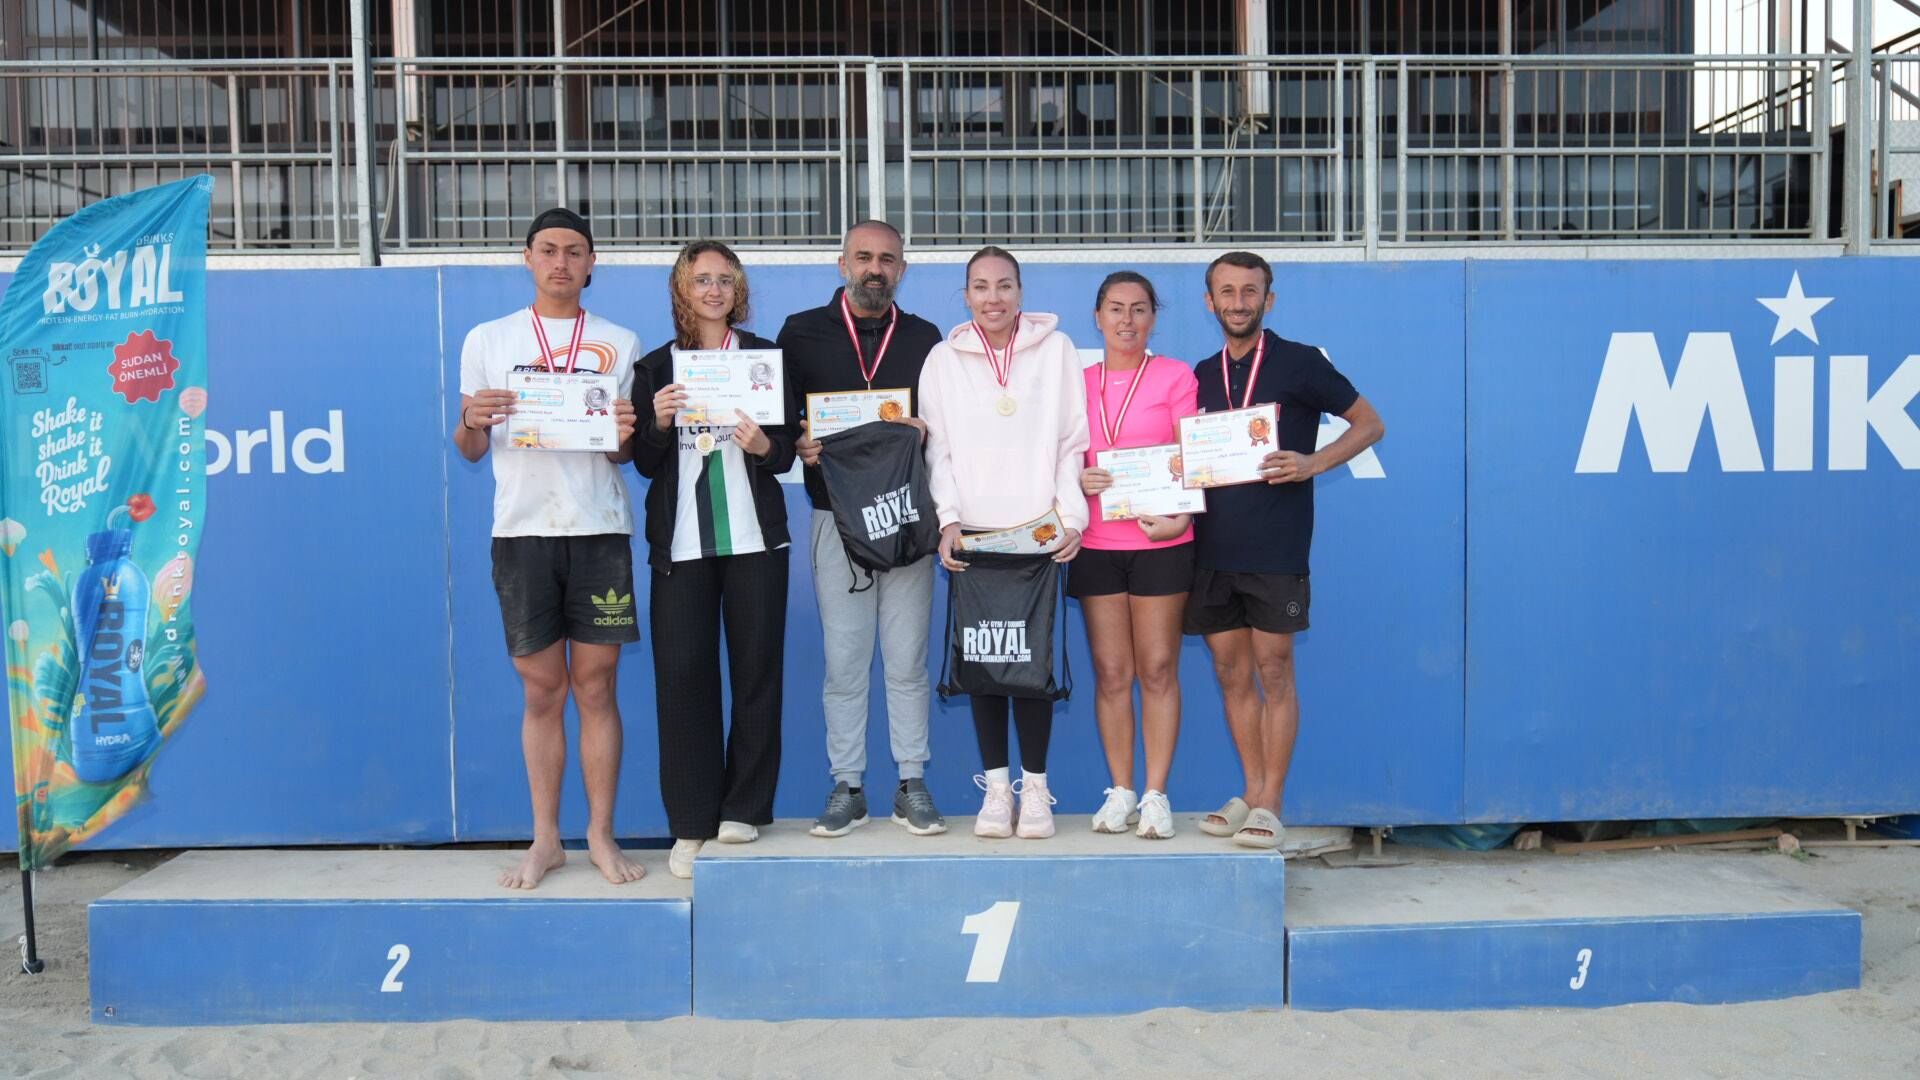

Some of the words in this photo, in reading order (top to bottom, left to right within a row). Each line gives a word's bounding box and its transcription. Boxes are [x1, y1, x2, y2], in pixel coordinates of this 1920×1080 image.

[136, 232, 175, 246] DRINKS
[43, 243, 184, 314] ROYAL
[119, 362, 168, 382] ÖNEMLİ
[121, 352, 163, 370] SUDAN
[31, 396, 87, 438] Shake
[90, 411, 103, 432] it
[38, 427, 86, 461] shake
[89, 436, 103, 457] it
[35, 450, 88, 488] Drink
[40, 456, 112, 516] Royal
[593, 615, 634, 626] adidas
[963, 627, 1031, 655] ROYAL
[89, 600, 127, 735] ROYAL
[96, 733, 131, 746] HYDRA
[961, 901, 1021, 982] 1
[381, 944, 411, 992] 2
[1569, 948, 1592, 990] 3
